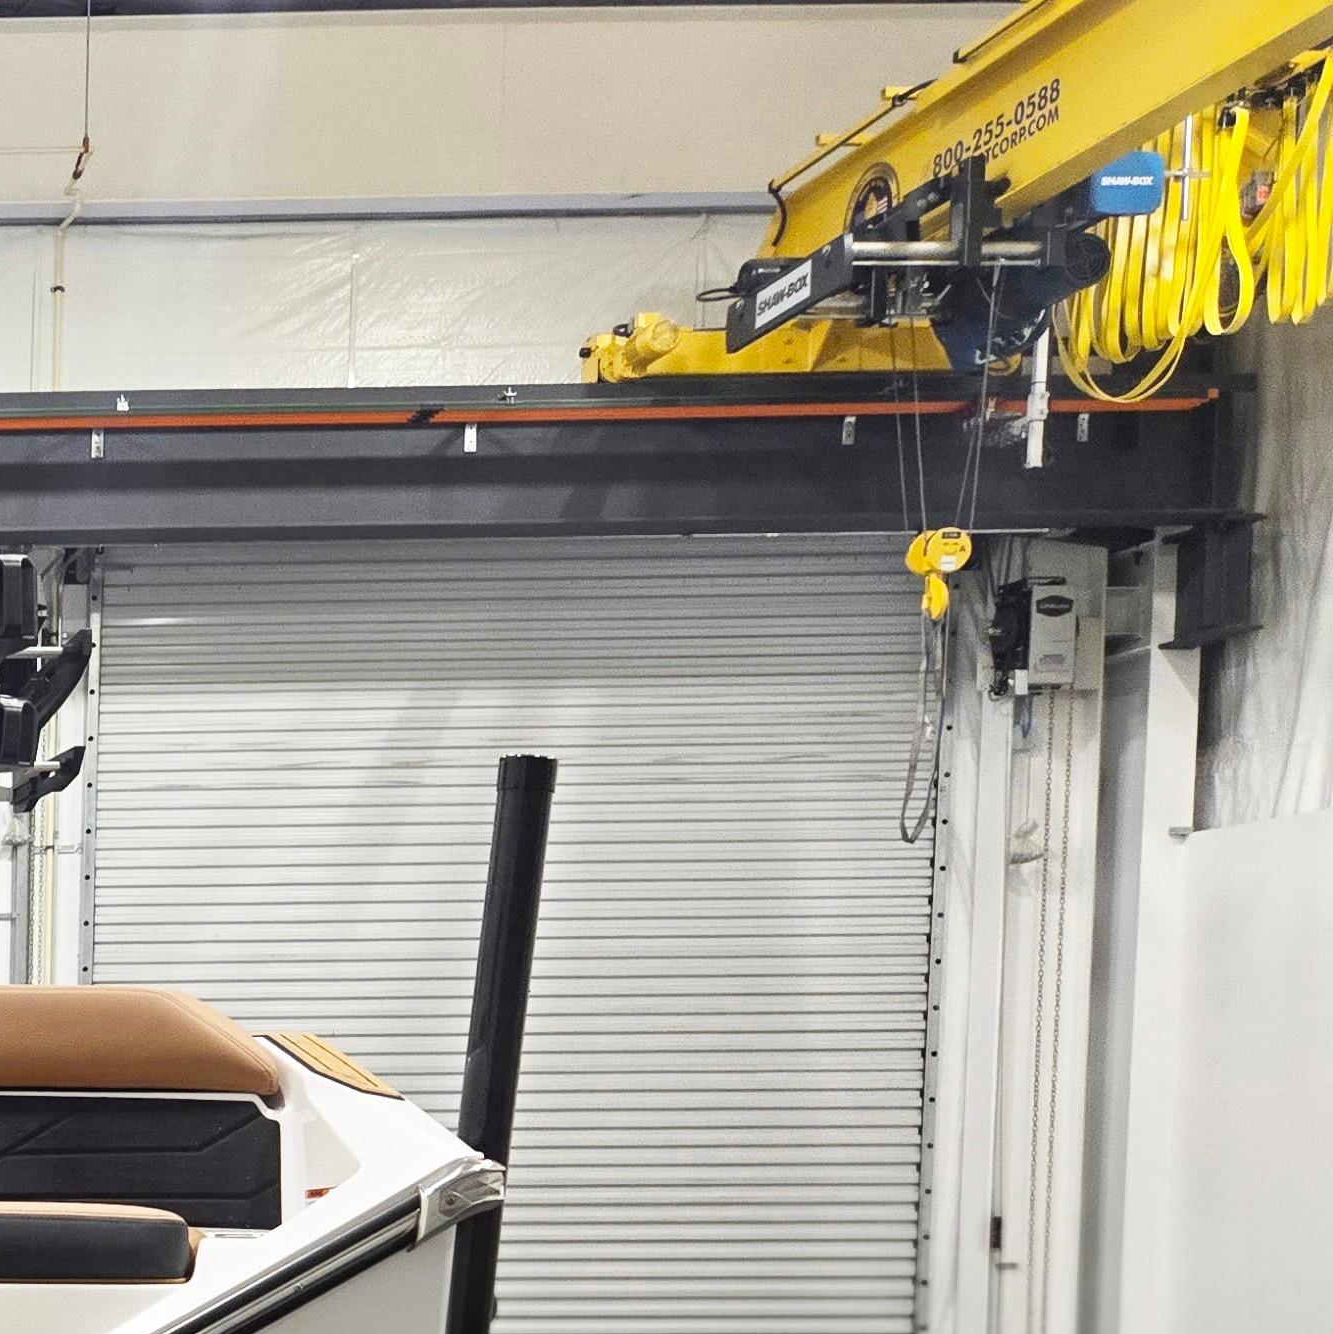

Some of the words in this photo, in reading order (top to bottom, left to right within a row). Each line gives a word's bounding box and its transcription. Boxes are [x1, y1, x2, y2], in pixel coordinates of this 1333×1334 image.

[932, 78, 1061, 178] 800-255-0588
[984, 105, 1060, 163] TCORP.COM
[757, 272, 809, 316] SHAW-BOX
